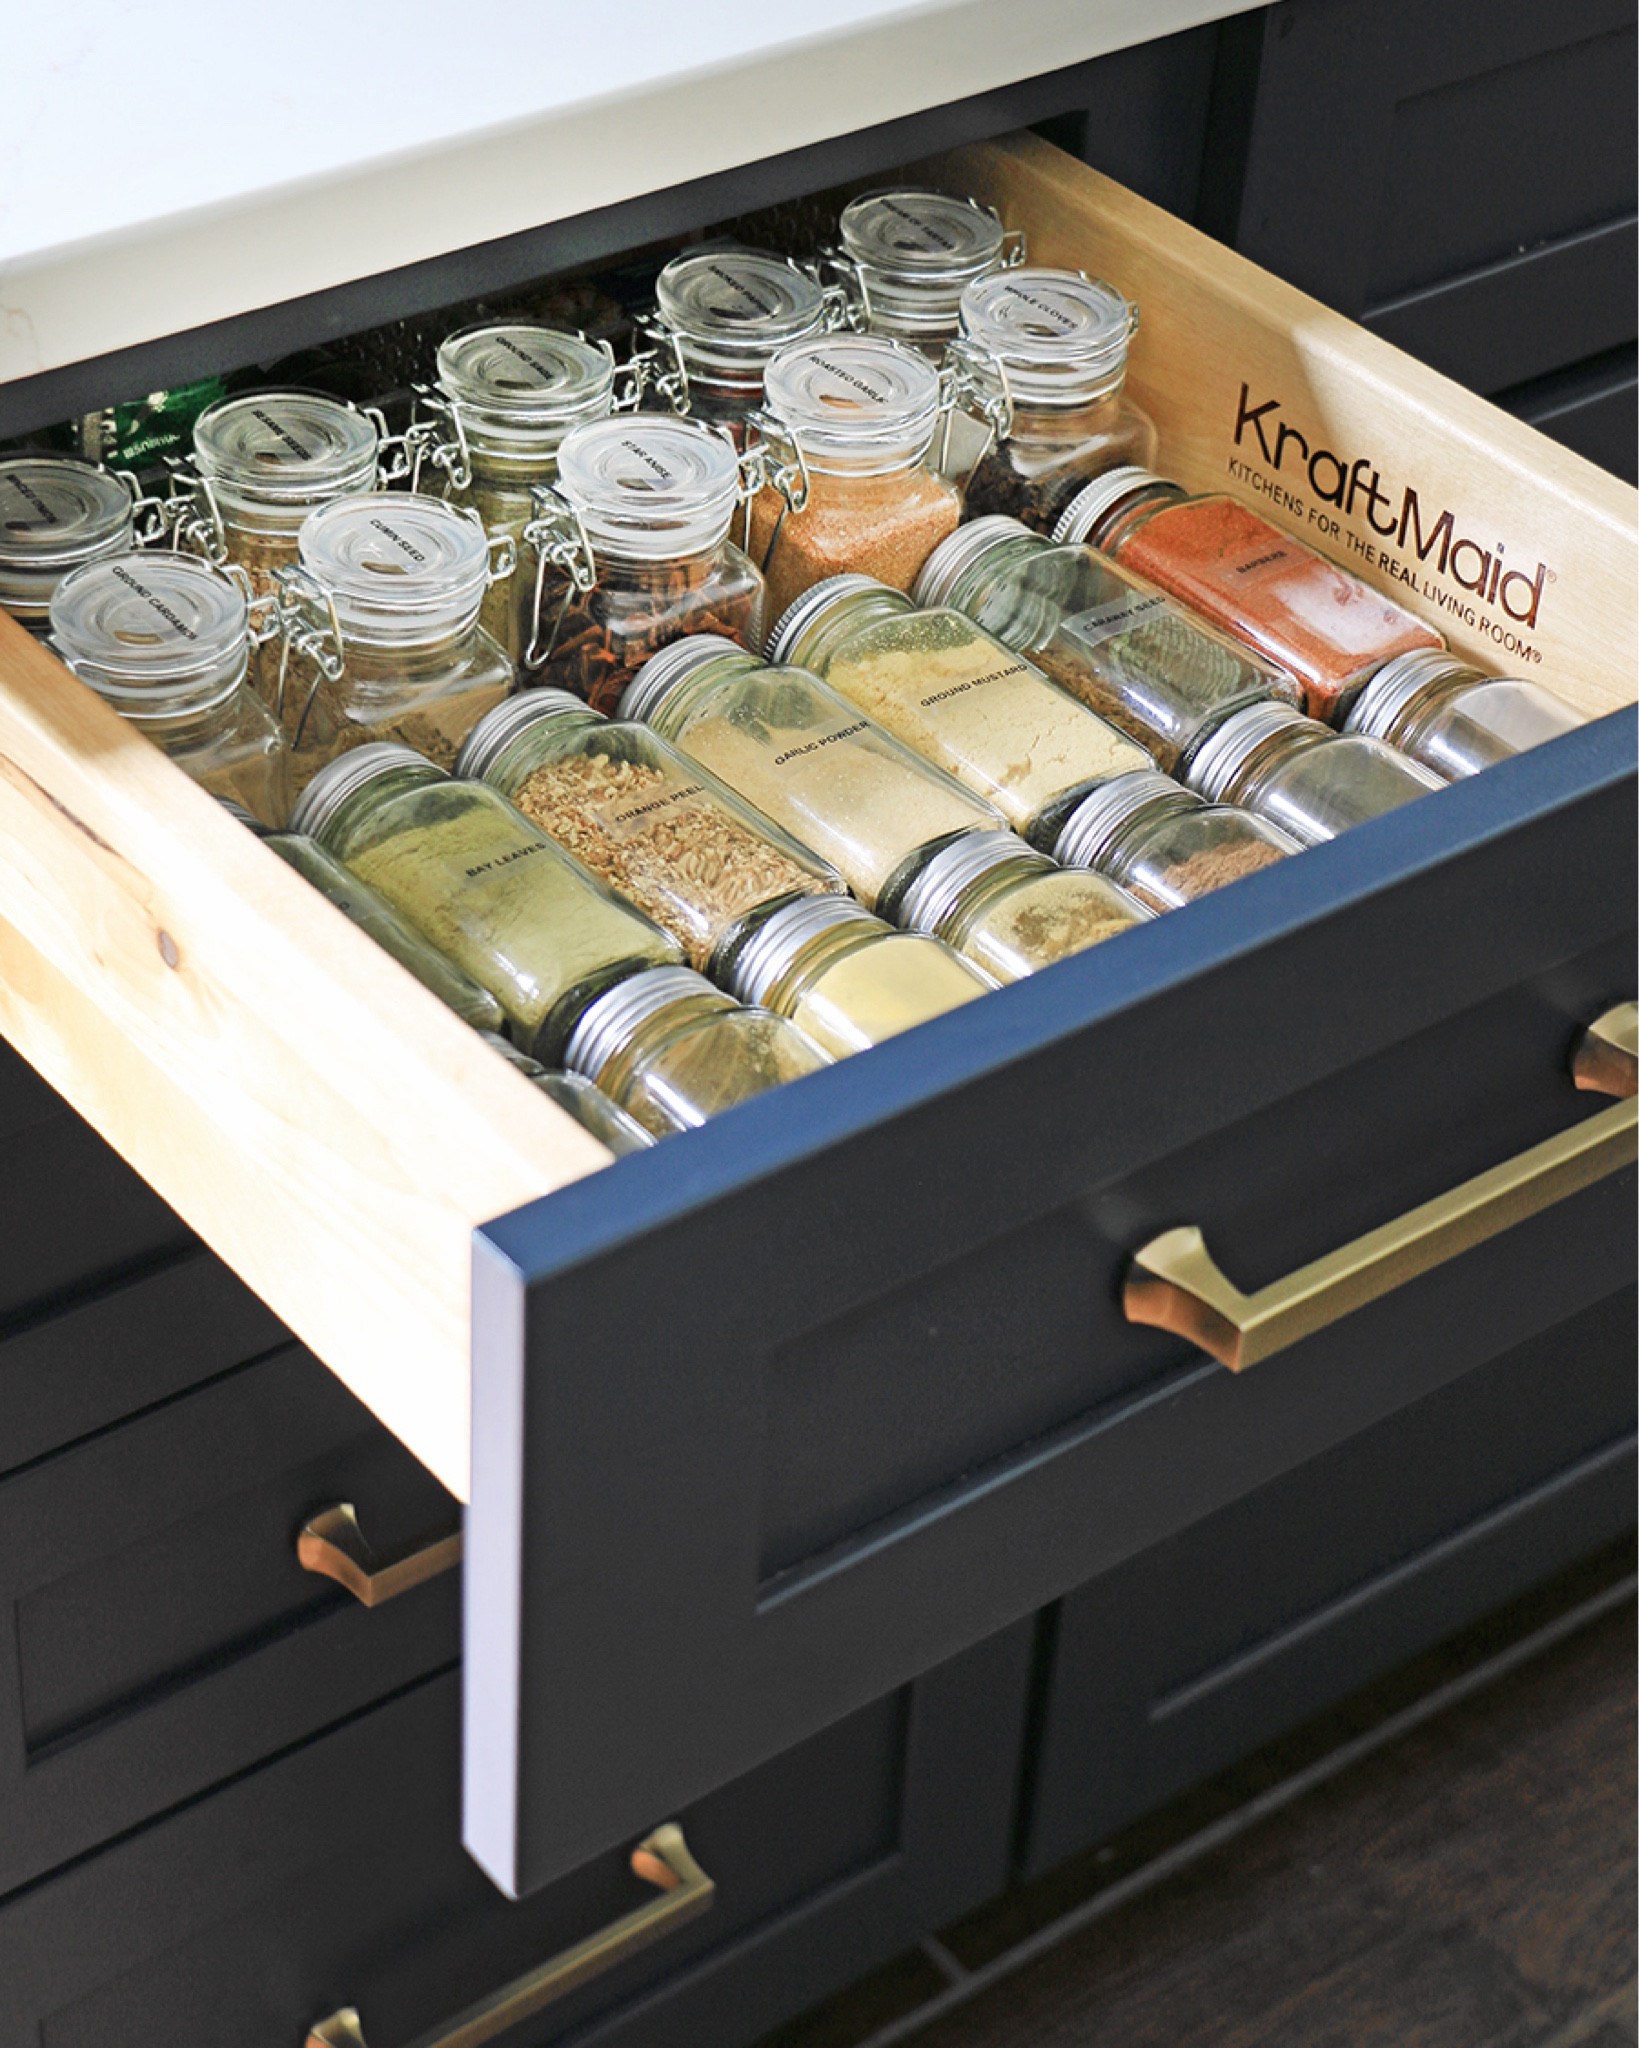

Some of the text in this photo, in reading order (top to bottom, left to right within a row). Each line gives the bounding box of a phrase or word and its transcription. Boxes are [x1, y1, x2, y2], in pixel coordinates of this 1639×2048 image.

[621, 440, 673, 480] STAR ANISE
[1228, 456, 1303, 518] KITCHENS
[1308, 508, 1341, 542] FOR
[1345, 530, 1375, 562] THE
[1378, 551, 1420, 594] REAL
[1423, 581, 1476, 628] LIVING
[112, 565, 152, 599] GROUND
[920, 663, 1028, 707] GROUND MUSTARD
[775, 720, 871, 765] GARLIC POWDER
[615, 784, 705, 822] ORANGE PEEL
[465, 842, 547, 878] BAY LEAVES
